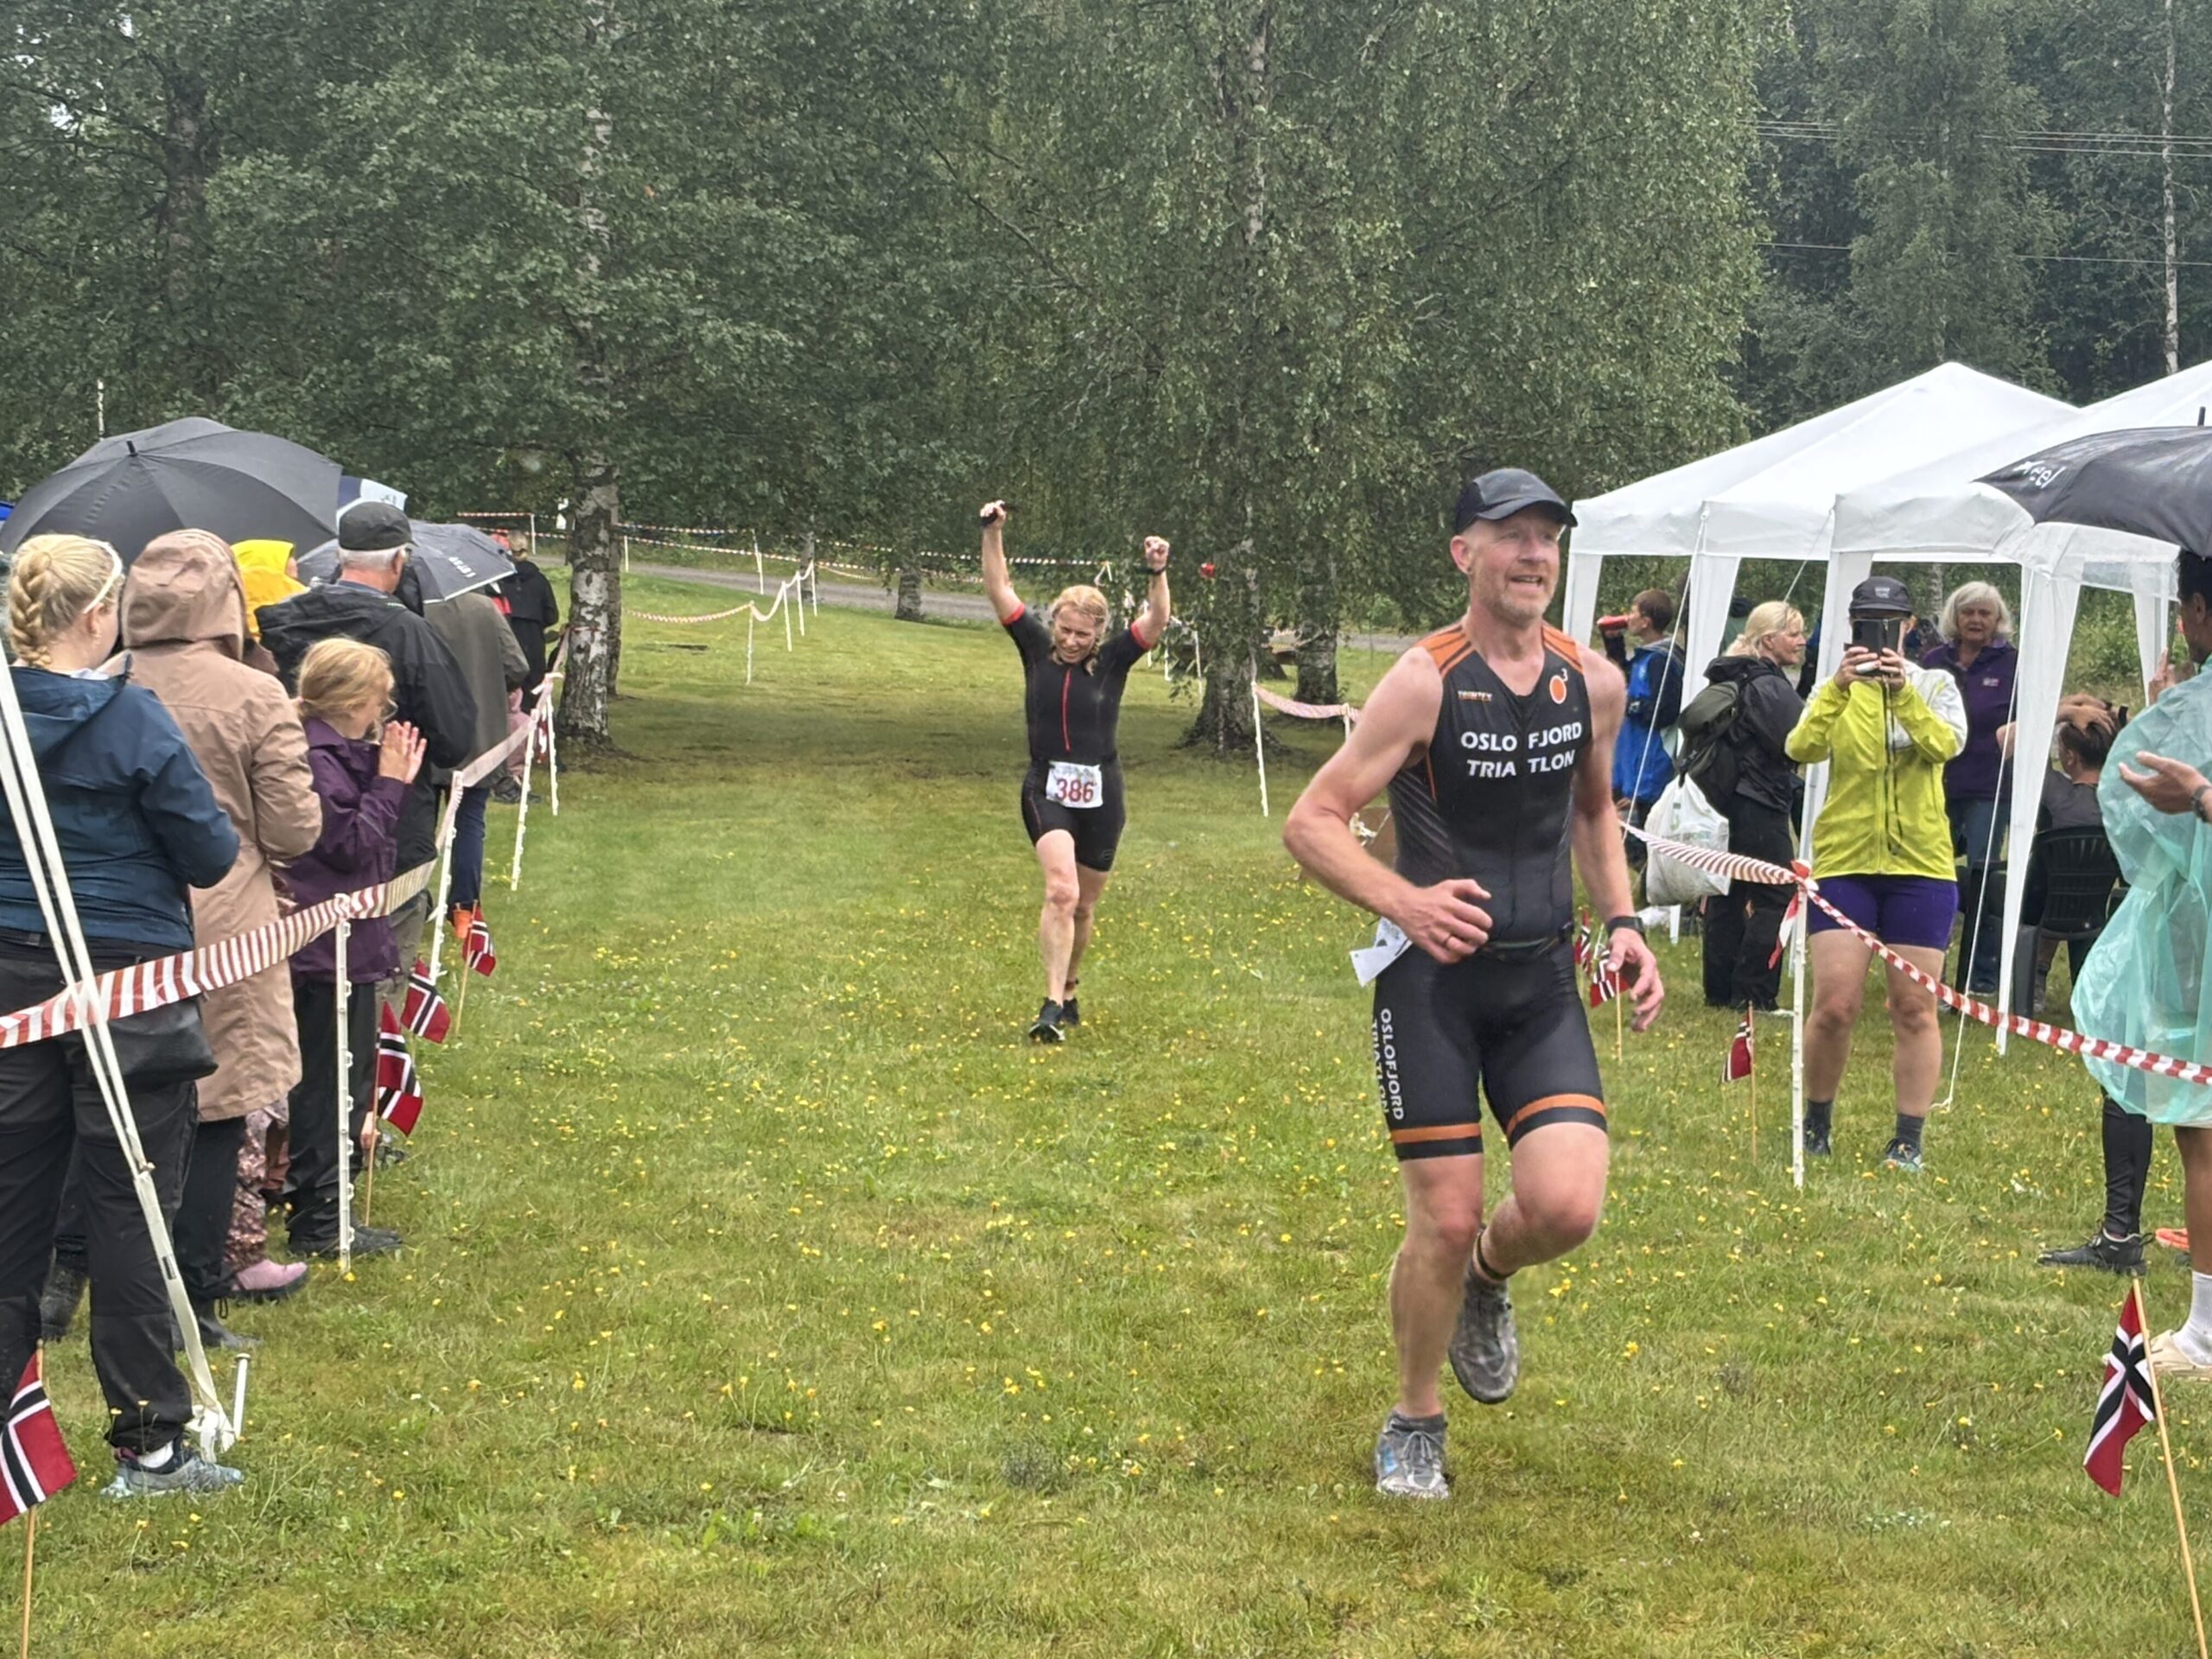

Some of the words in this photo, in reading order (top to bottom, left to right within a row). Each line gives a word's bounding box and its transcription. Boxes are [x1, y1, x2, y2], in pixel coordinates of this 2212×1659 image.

[1460, 731, 1517, 752] OSLO
[1528, 721, 1582, 749] FJORD
[1466, 760, 1516, 779] TRIA
[1528, 749, 1575, 774] TLON
[1055, 779, 1095, 803] 386
[1381, 1008, 1404, 1121] OSLOFJORD
